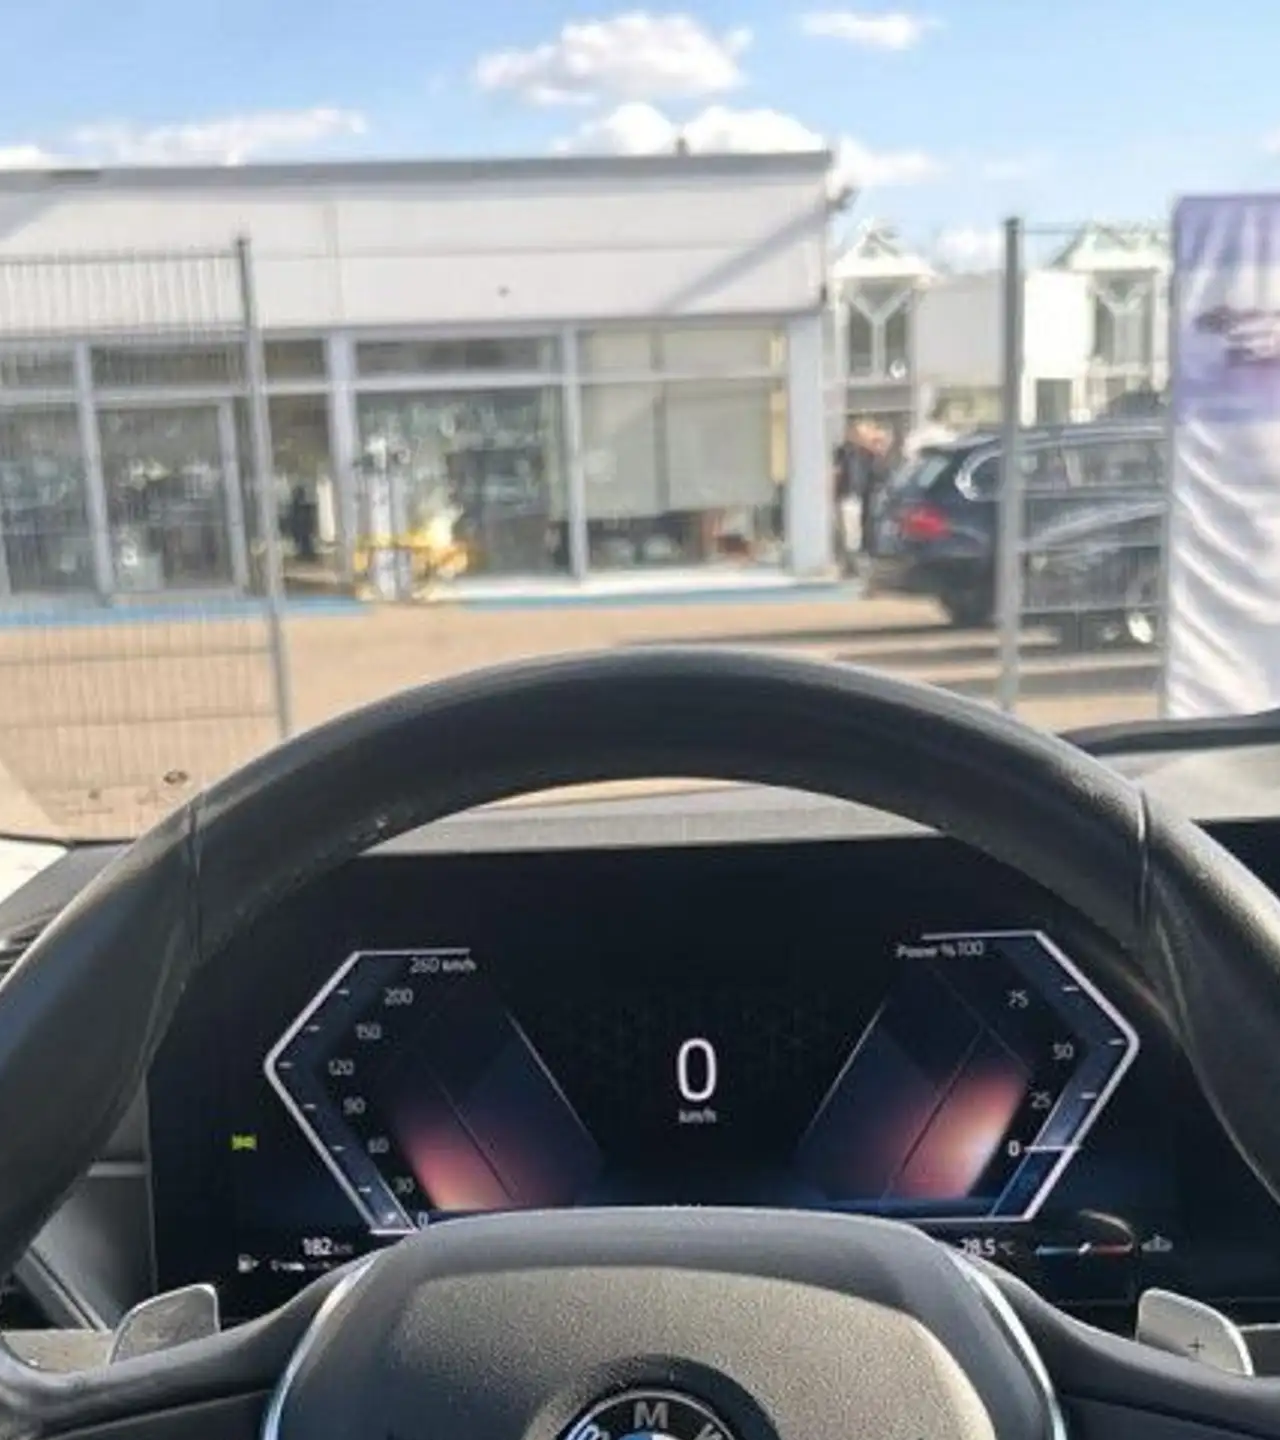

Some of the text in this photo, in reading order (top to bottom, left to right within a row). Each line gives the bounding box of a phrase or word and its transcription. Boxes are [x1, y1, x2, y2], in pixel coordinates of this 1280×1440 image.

[409, 957, 477, 974] 260 km/h
[384, 988, 413, 1005] 200
[1007, 990, 1030, 1009] 75
[356, 1023, 381, 1040] 150
[1052, 1044, 1074, 1061] 50
[328, 1060, 354, 1076] 120
[677, 1037, 717, 1102] 0
[343, 1096, 366, 1114] 90
[1030, 1091, 1052, 1110] 25
[678, 1106, 717, 1124] km/h
[368, 1136, 390, 1153] 60
[1007, 1140, 1020, 1157] 0
[301, 1237, 334, 1256] 182
